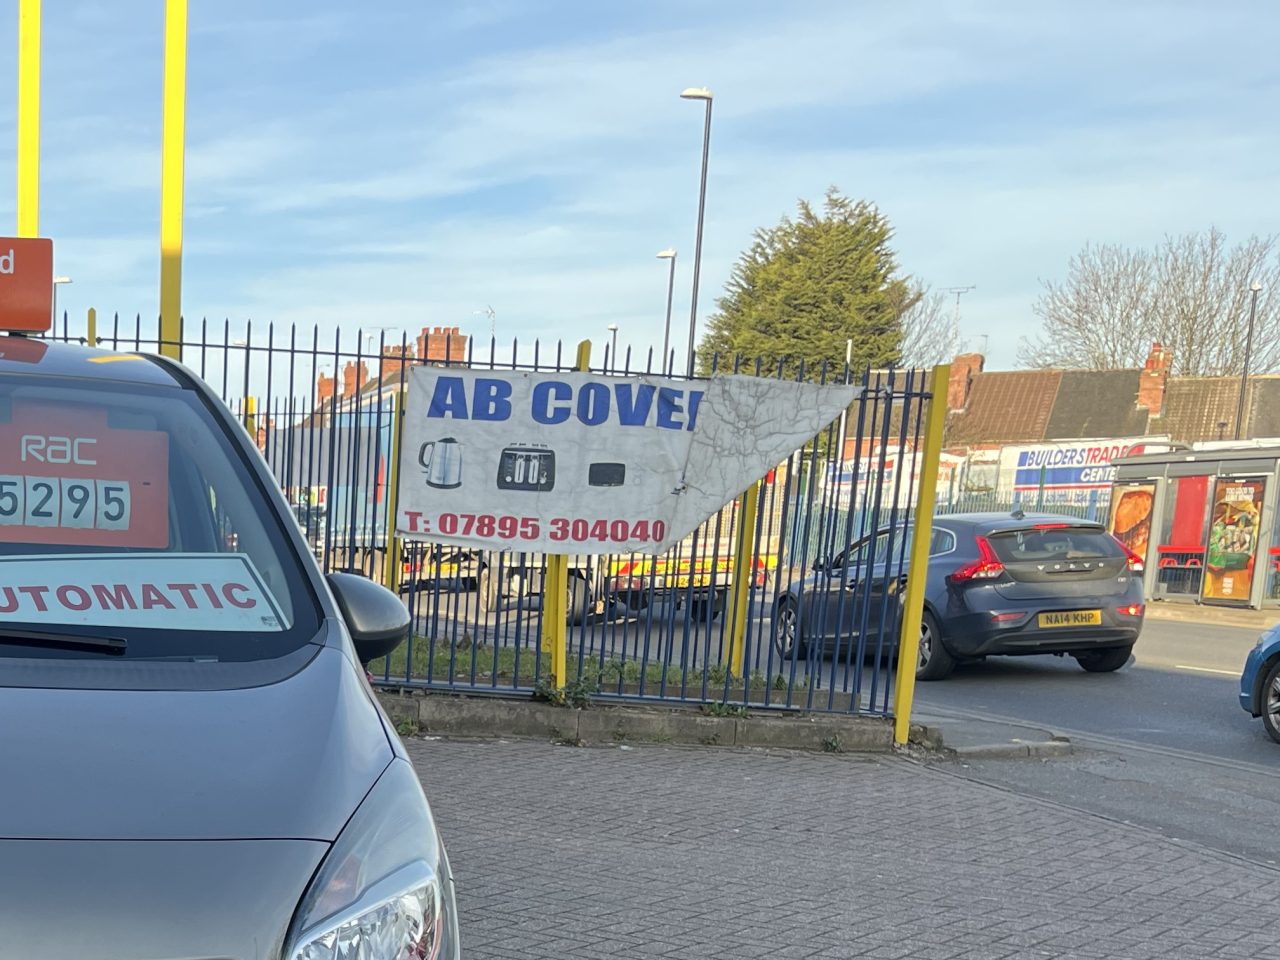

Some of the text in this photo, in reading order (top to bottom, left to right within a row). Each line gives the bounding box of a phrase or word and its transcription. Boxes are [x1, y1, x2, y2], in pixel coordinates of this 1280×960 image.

[427, 376, 513, 421] AB
[438, 512, 540, 540] 07895
[549, 519, 665, 543] 304040
[1073, 613, 1094, 623] KHP
